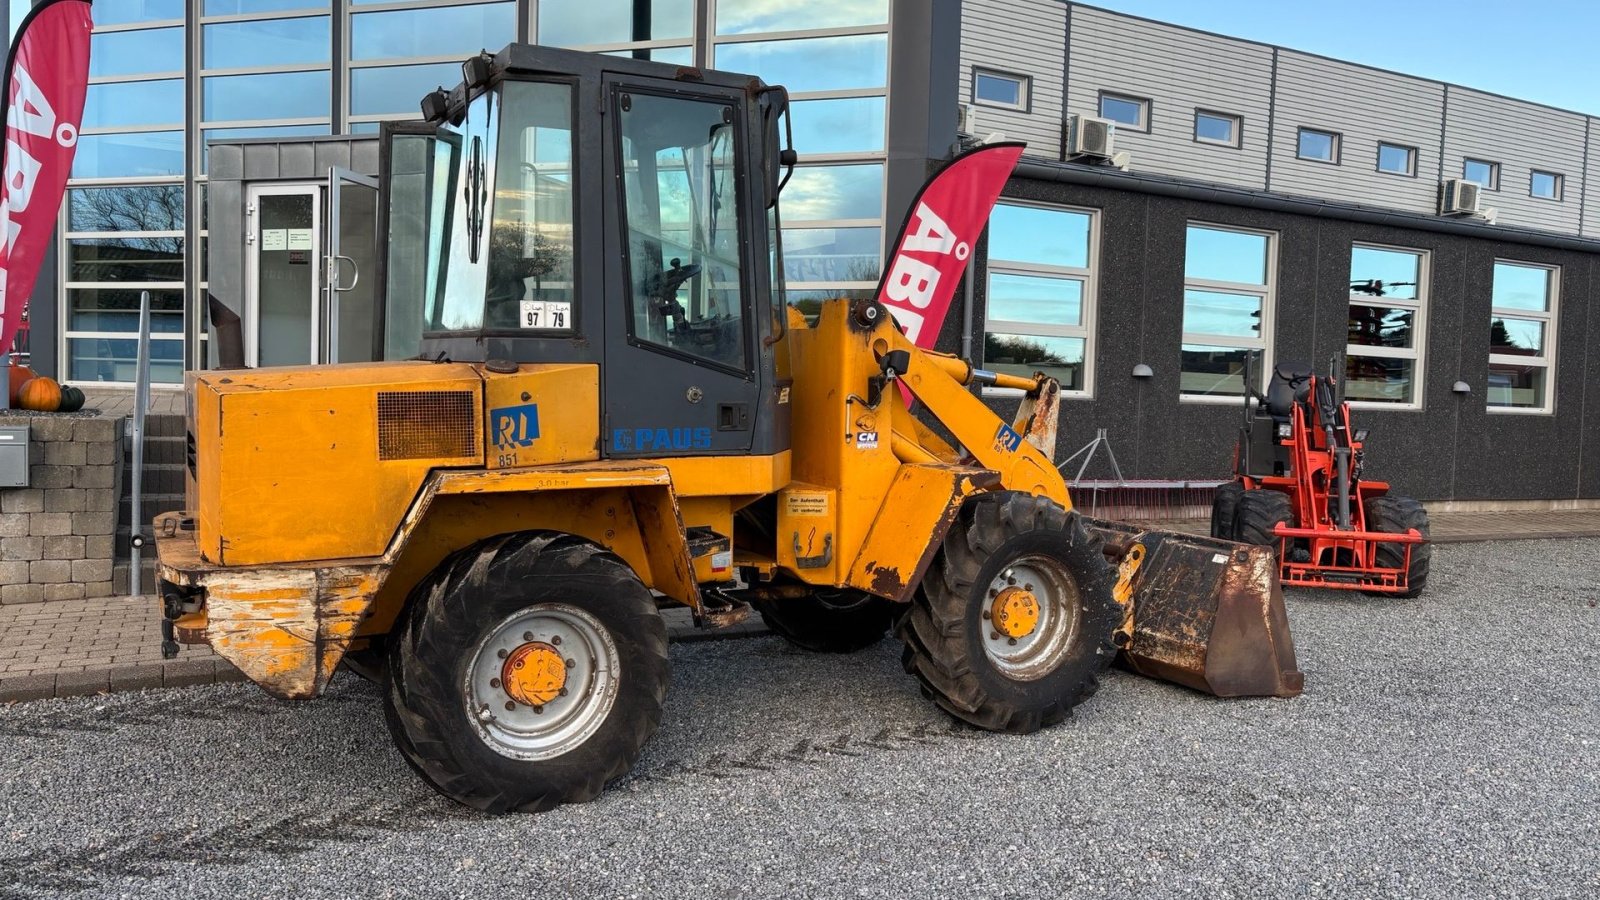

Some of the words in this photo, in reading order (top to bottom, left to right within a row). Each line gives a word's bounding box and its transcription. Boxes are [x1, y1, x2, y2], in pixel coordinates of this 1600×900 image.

[527, 312, 539, 326] 97
[552, 312, 564, 328] 79
[499, 453, 518, 468] 851
